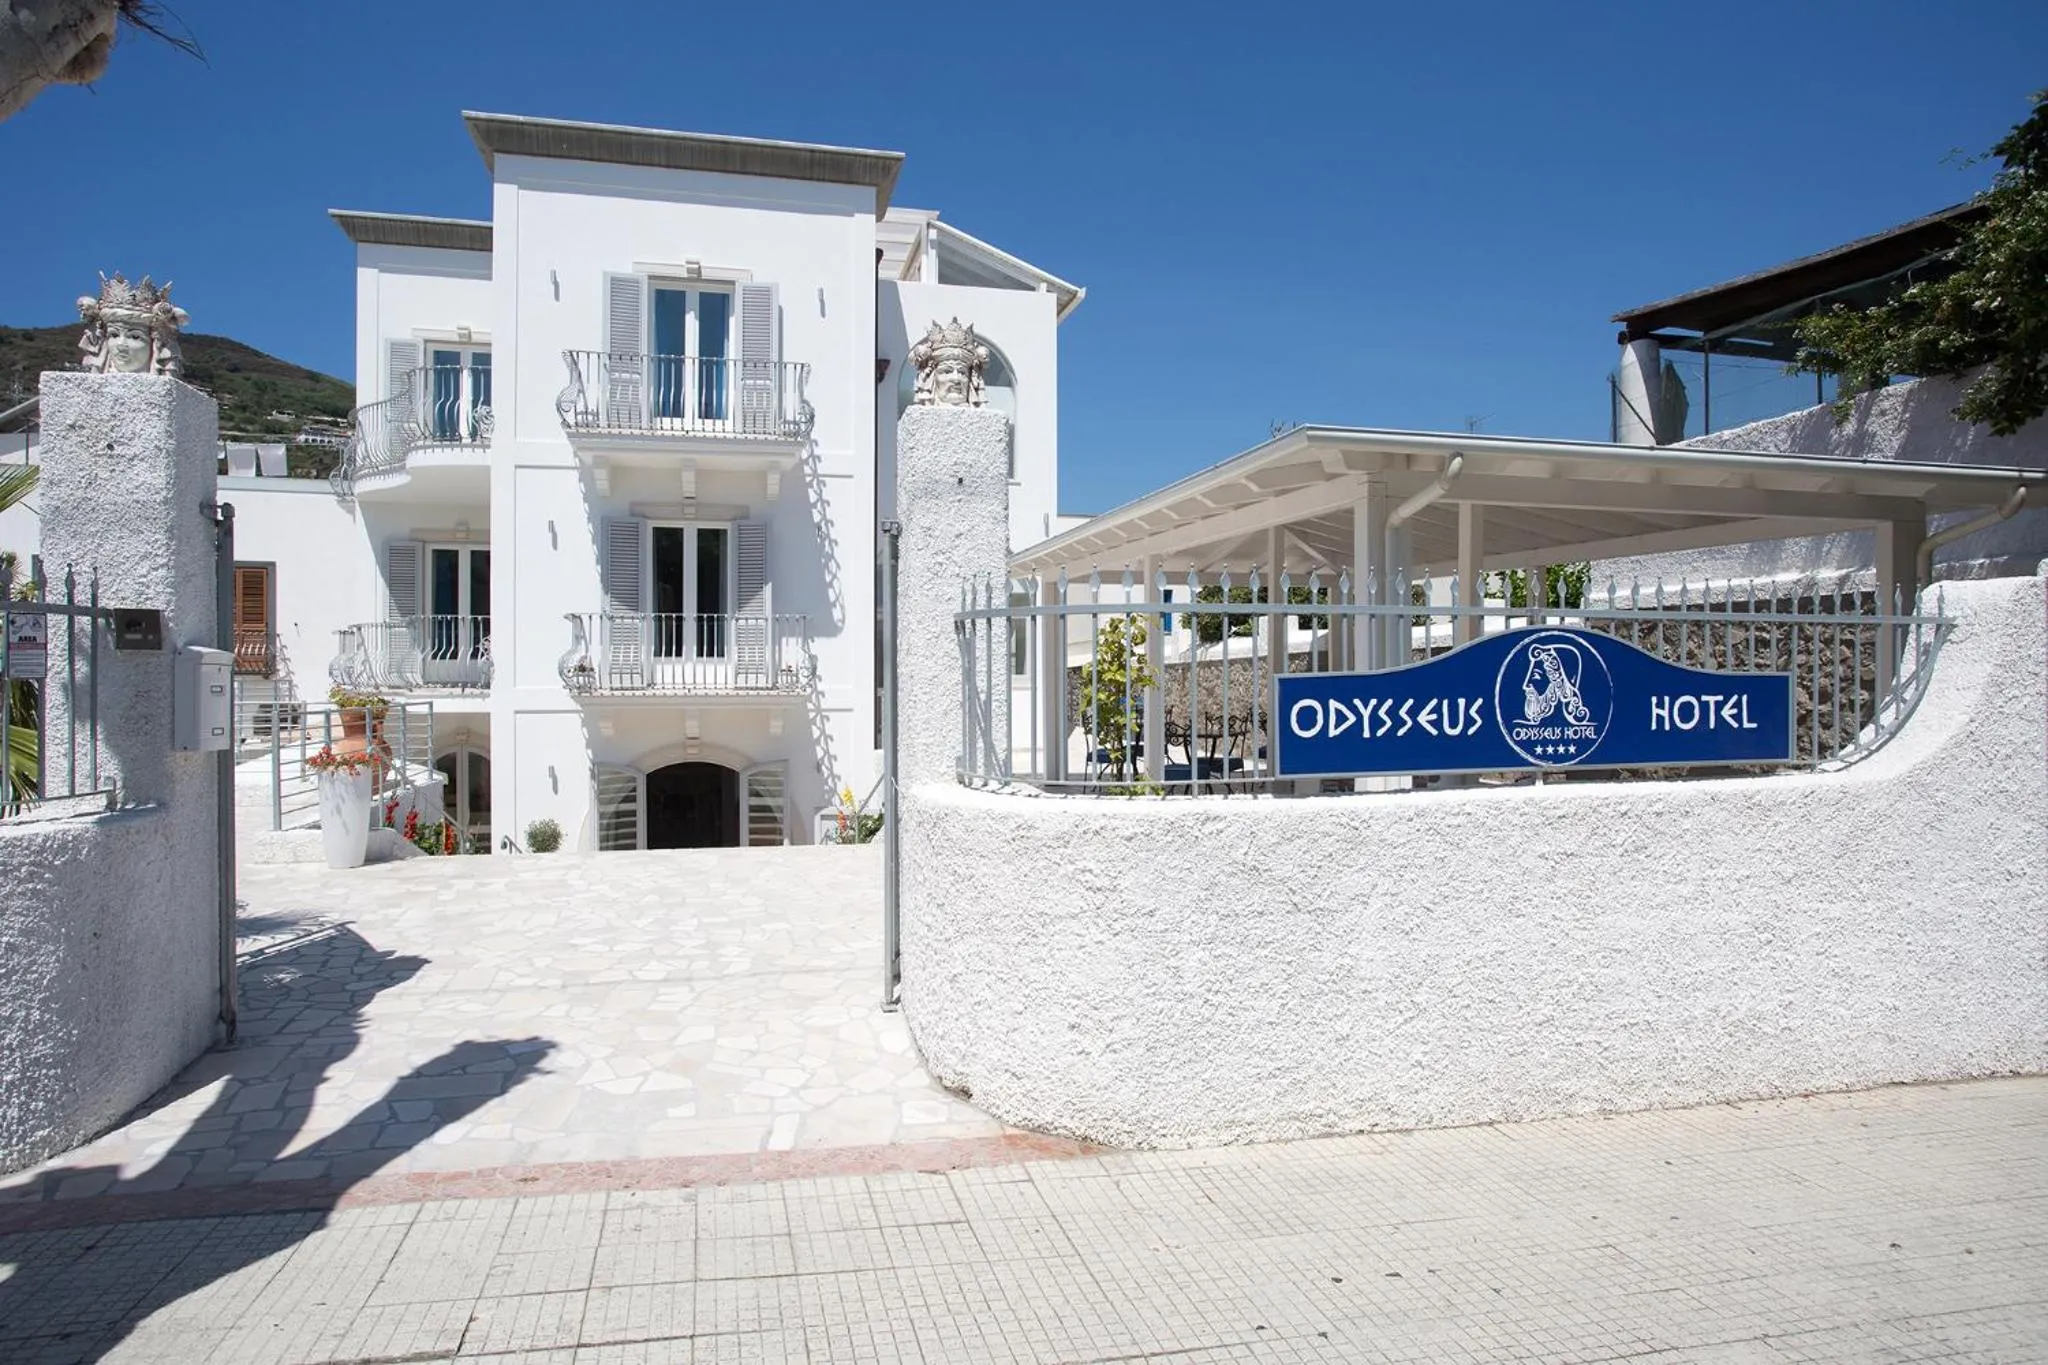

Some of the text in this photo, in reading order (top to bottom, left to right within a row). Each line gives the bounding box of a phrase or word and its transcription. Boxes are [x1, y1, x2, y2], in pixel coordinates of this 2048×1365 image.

[1290, 693, 1758, 739] ODYSSEUS HOTEL
[1512, 725, 1598, 741] ODYSSEUS HOTEL
